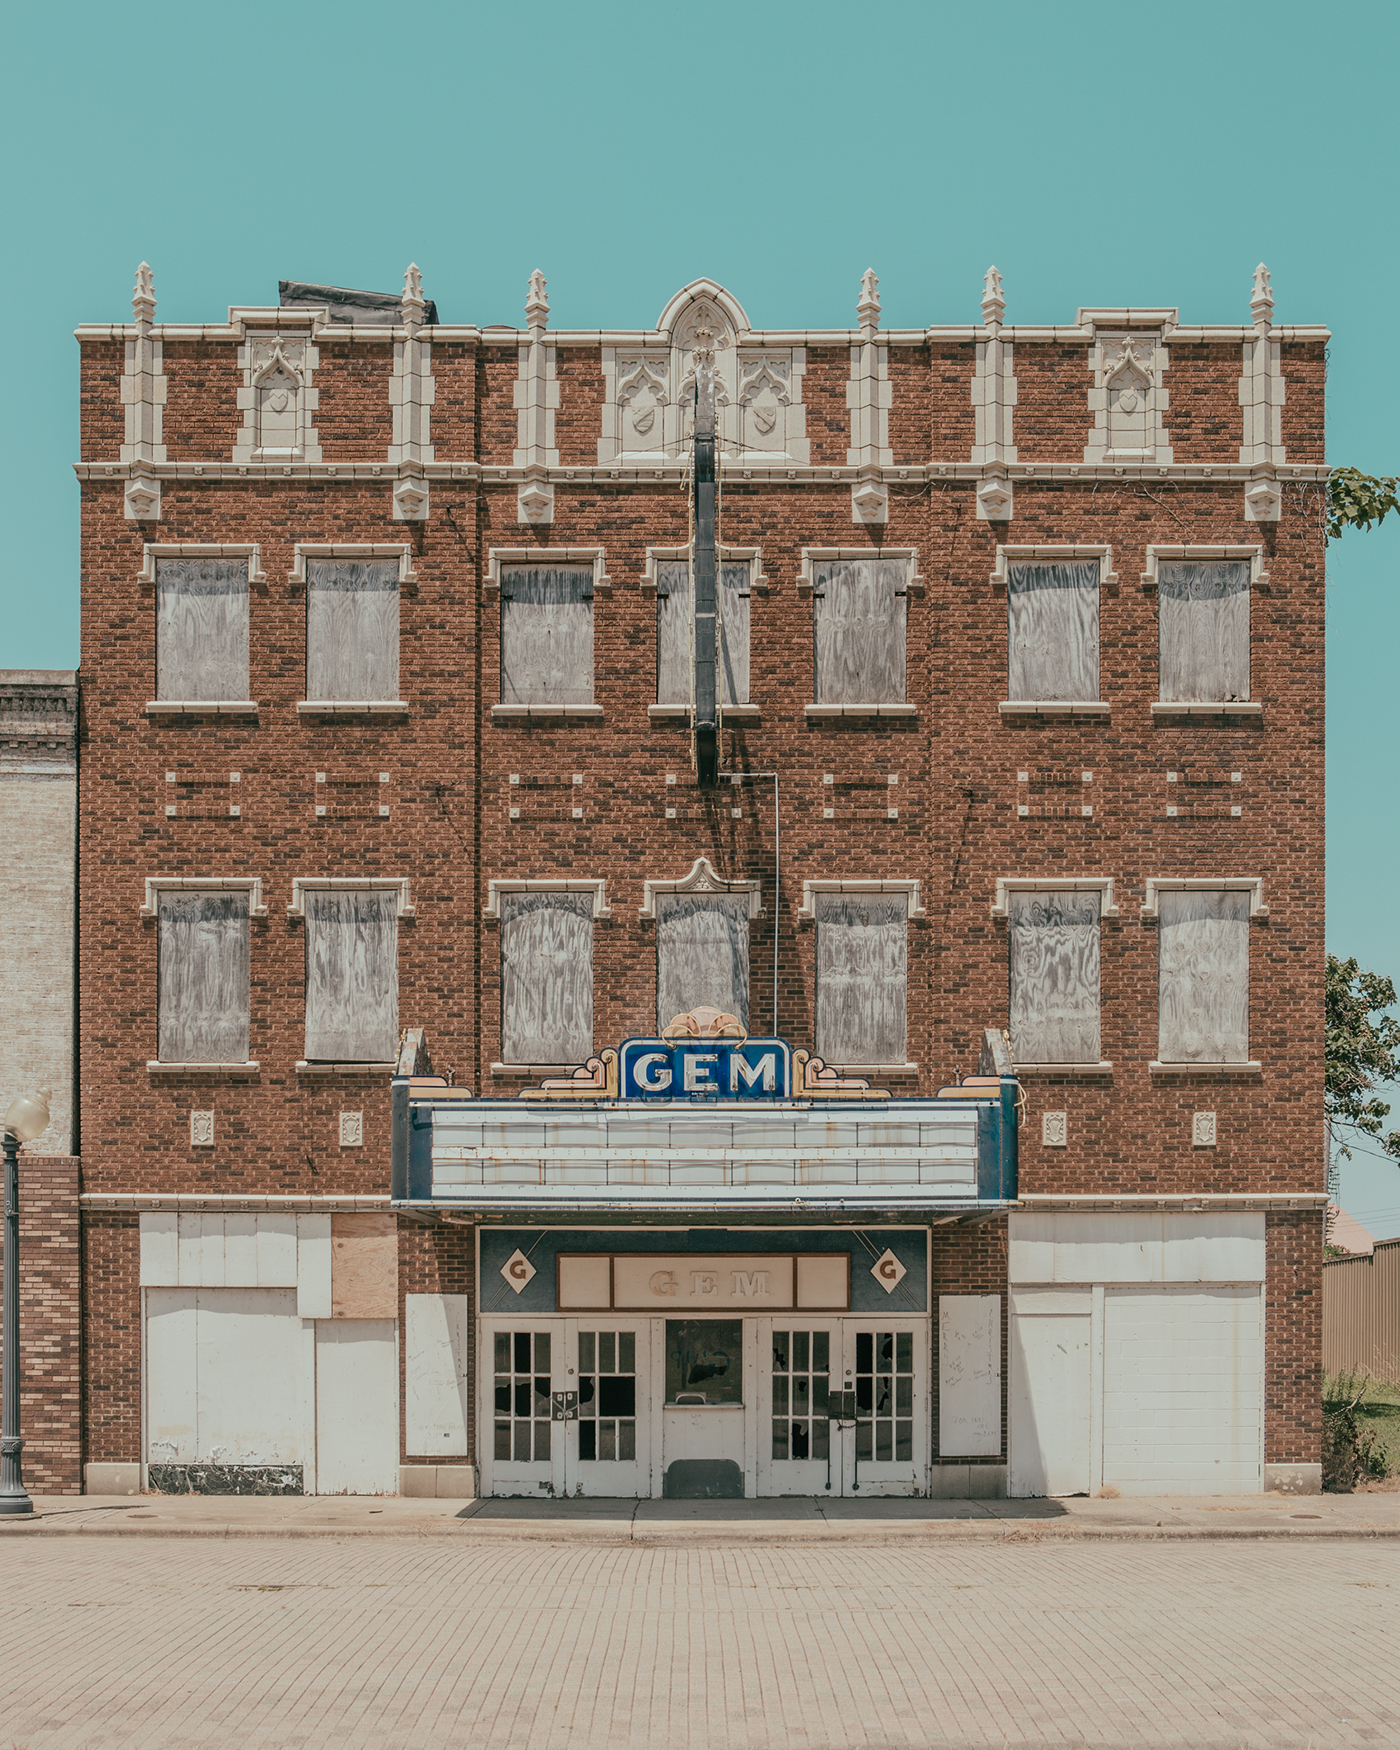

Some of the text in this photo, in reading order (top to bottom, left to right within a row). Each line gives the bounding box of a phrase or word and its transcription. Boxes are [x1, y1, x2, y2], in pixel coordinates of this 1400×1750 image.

[633, 1053, 776, 1091] GEM
[509, 1260, 526, 1279] G
[880, 1260, 897, 1279] G
[648, 1270, 770, 1297] GEM
